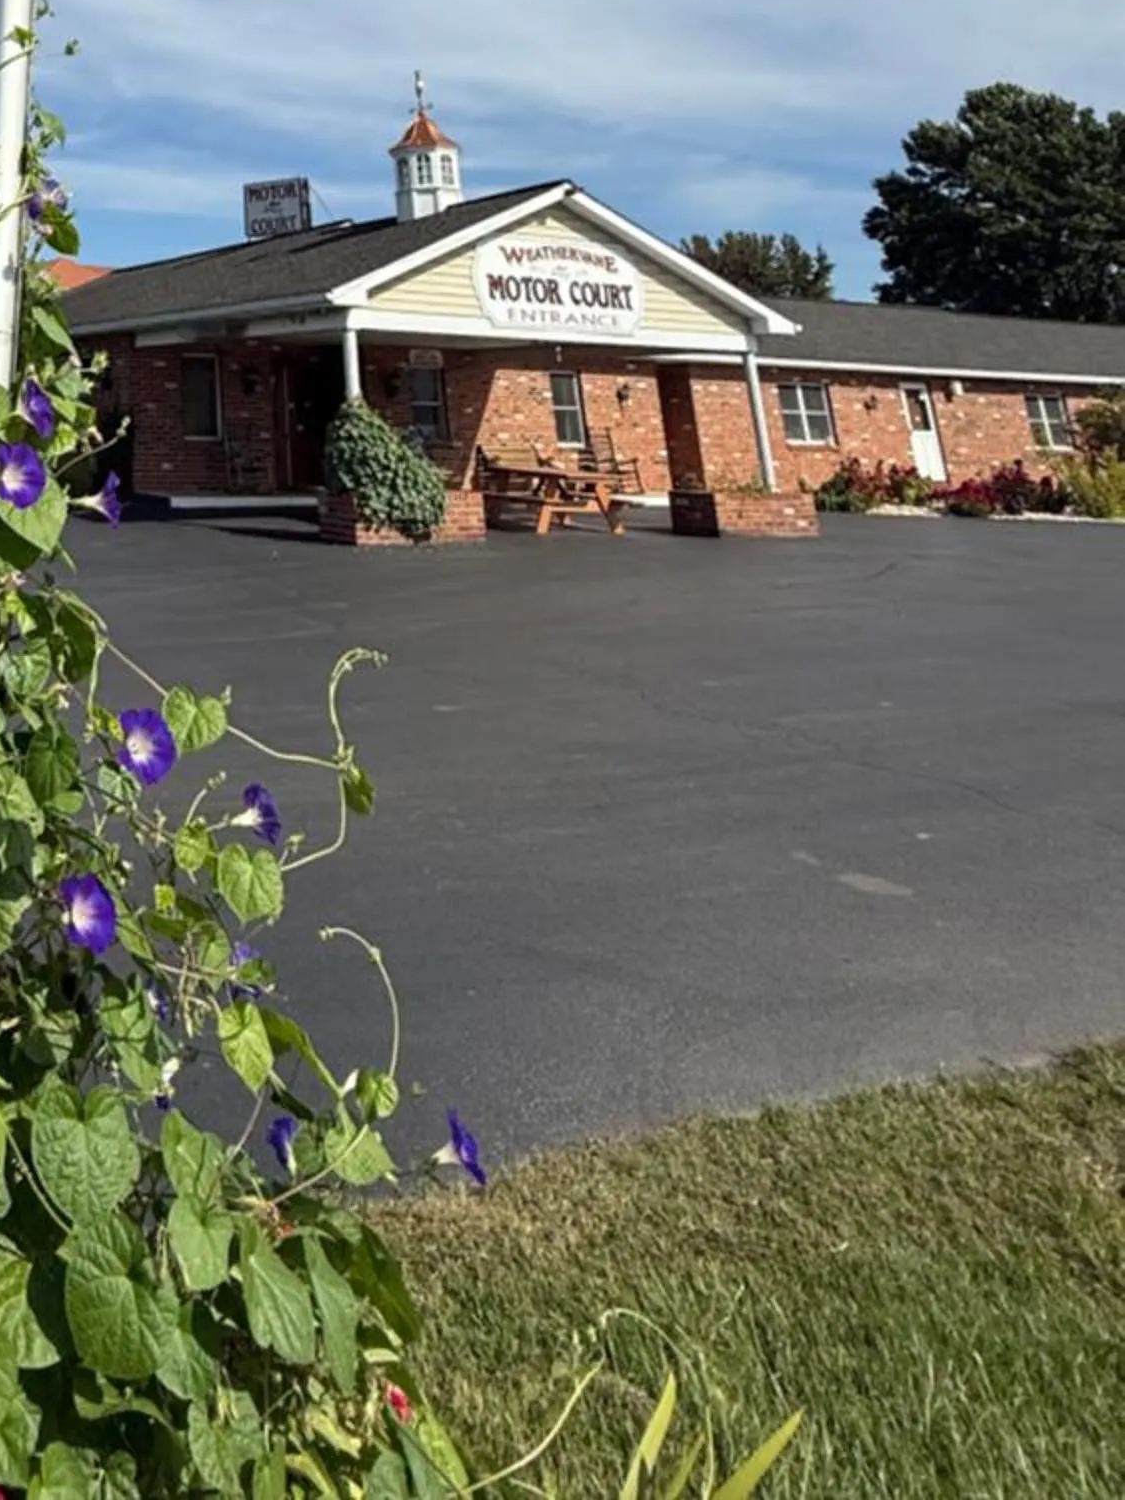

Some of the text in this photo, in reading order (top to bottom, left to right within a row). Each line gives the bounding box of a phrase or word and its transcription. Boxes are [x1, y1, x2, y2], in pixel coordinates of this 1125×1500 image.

[248, 182, 298, 203] MOTOR
[250, 215, 298, 237] COURT
[498, 244, 619, 274] WEATHERVANE
[486, 273, 634, 312] MOTOR COURT
[506, 307, 619, 327] ENTRANCE
